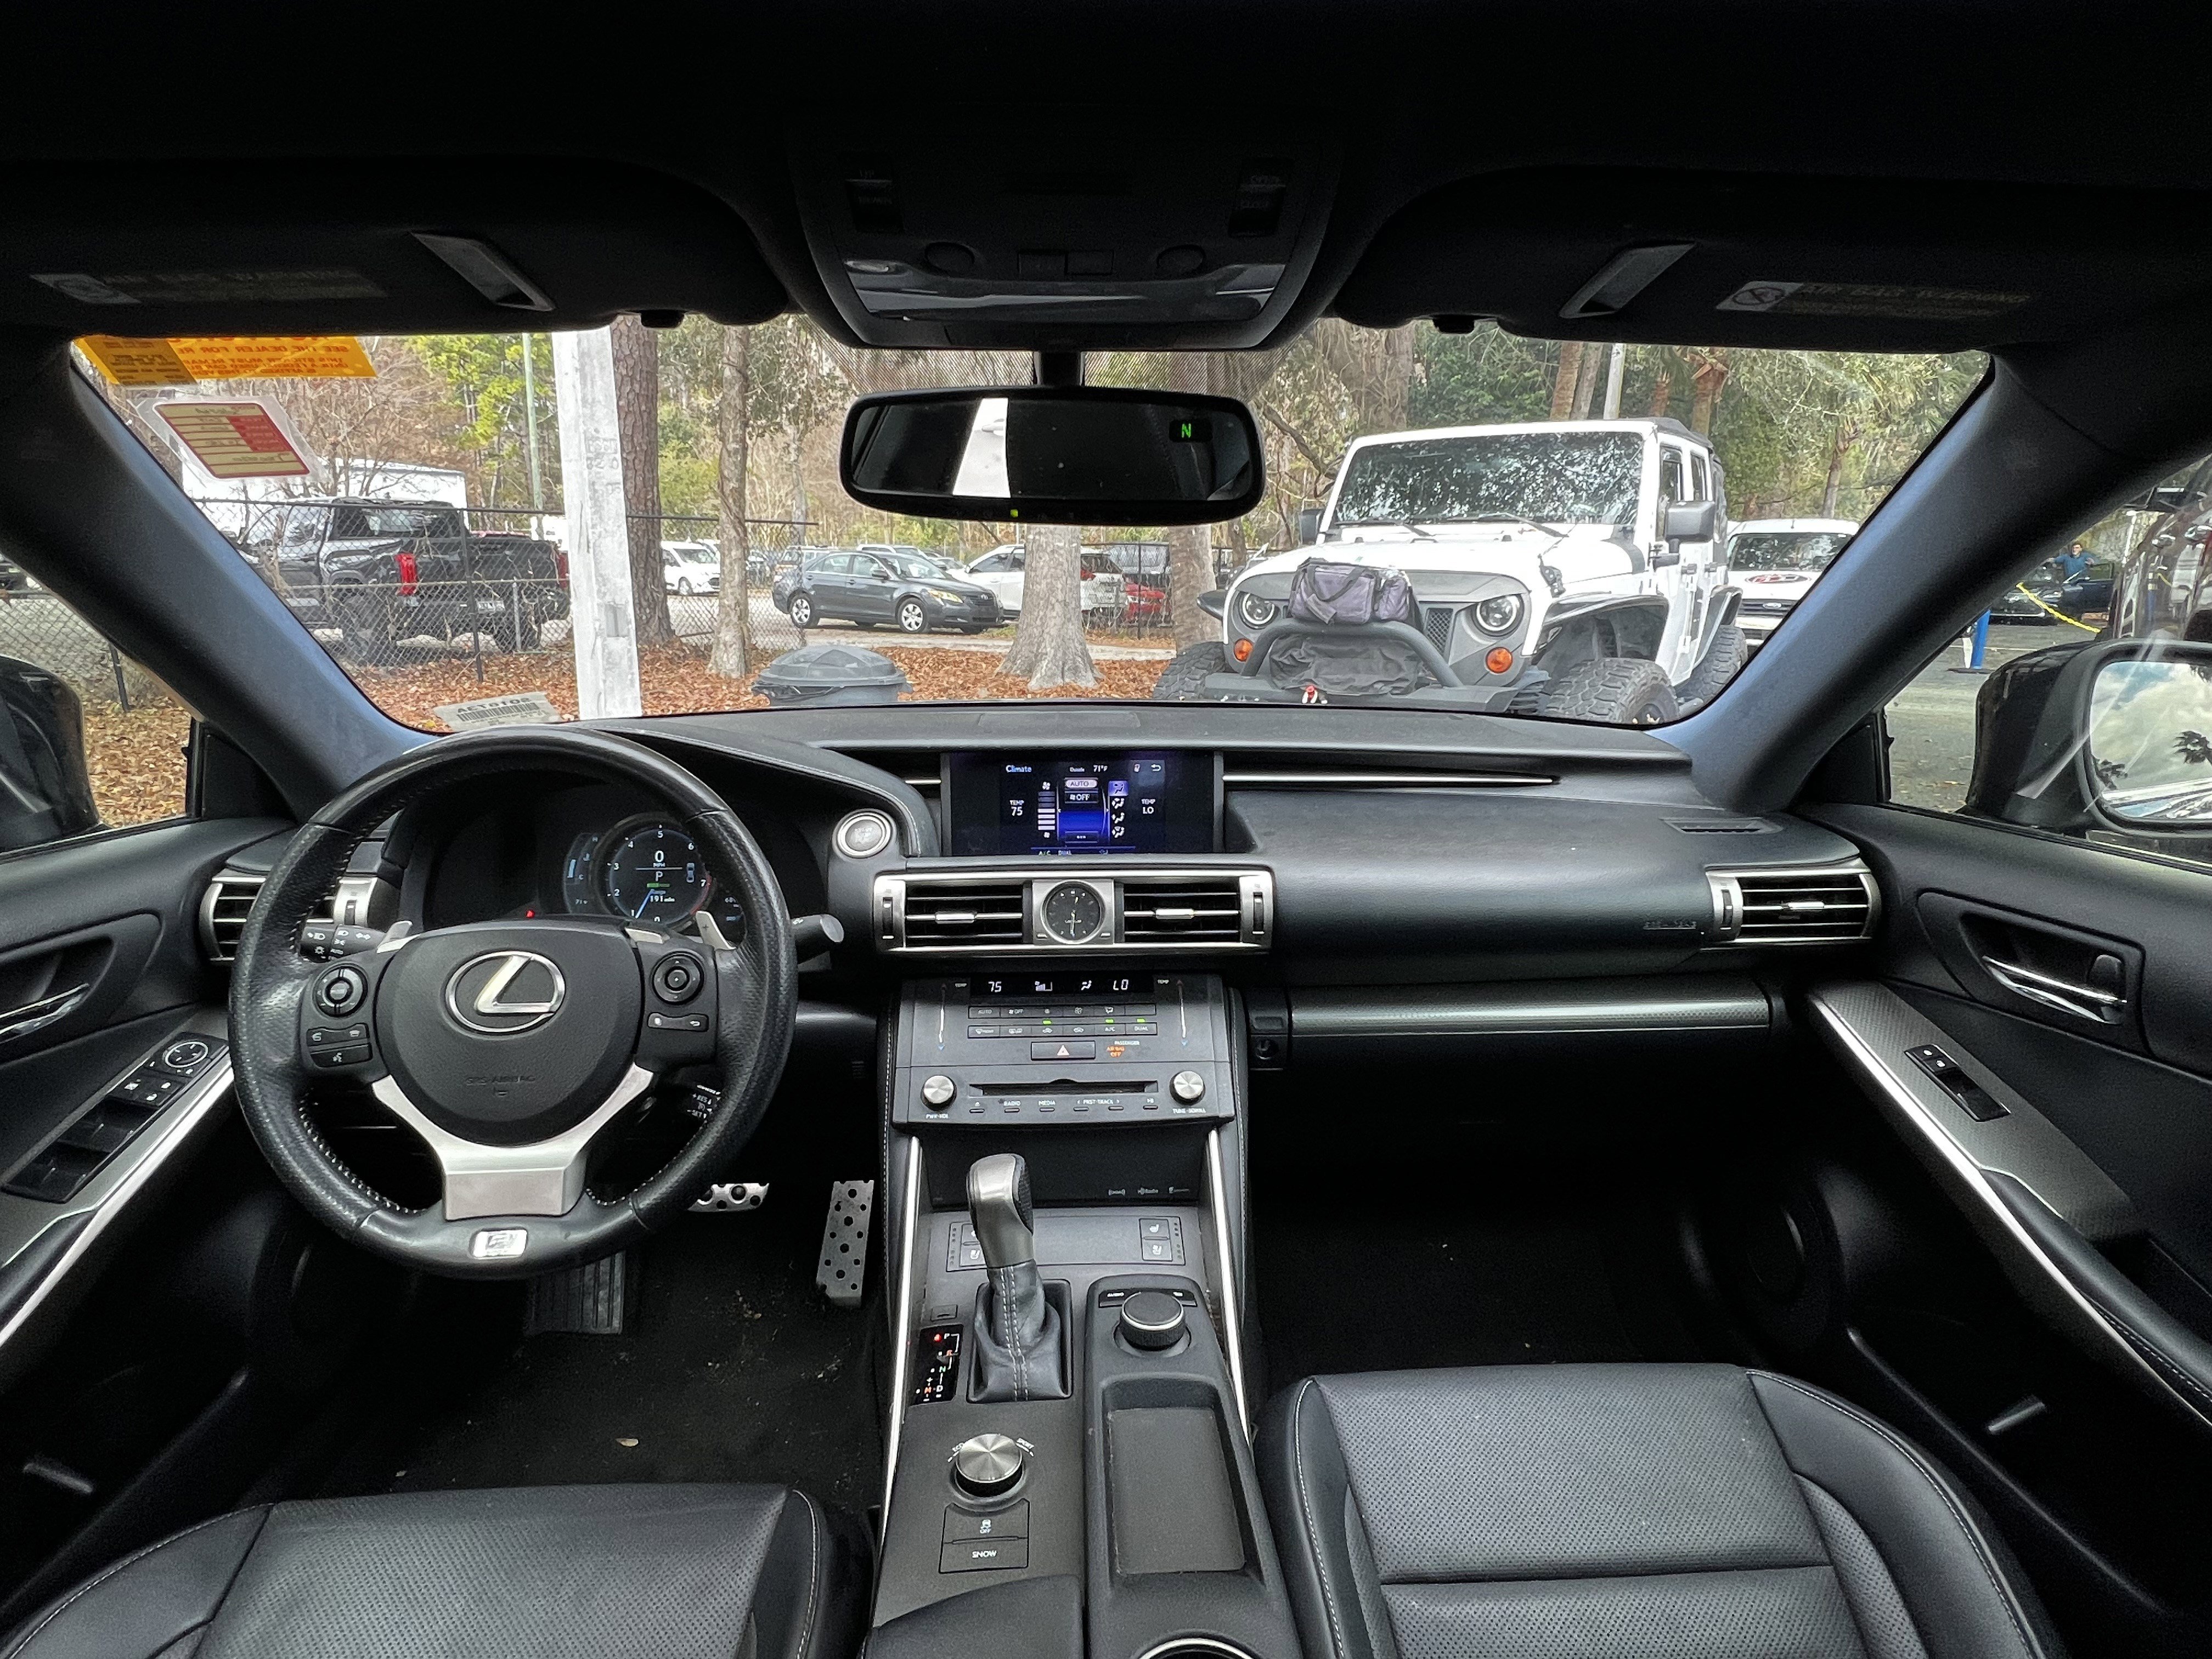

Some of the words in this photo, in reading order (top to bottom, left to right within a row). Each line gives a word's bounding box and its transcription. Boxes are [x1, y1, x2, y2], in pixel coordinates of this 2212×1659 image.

[1182, 423, 1192, 438] N
[1006, 765, 1032, 773] Climate
[1011, 807, 1023, 816] 75
[1142, 806, 1154, 815] LO
[628, 840, 634, 849] 4
[655, 871, 663, 882] P
[700, 879, 707, 887] 7
[614, 888, 620, 896] 2
[988, 981, 1002, 992] 75
[972, 1549, 997, 1558] SNOW
